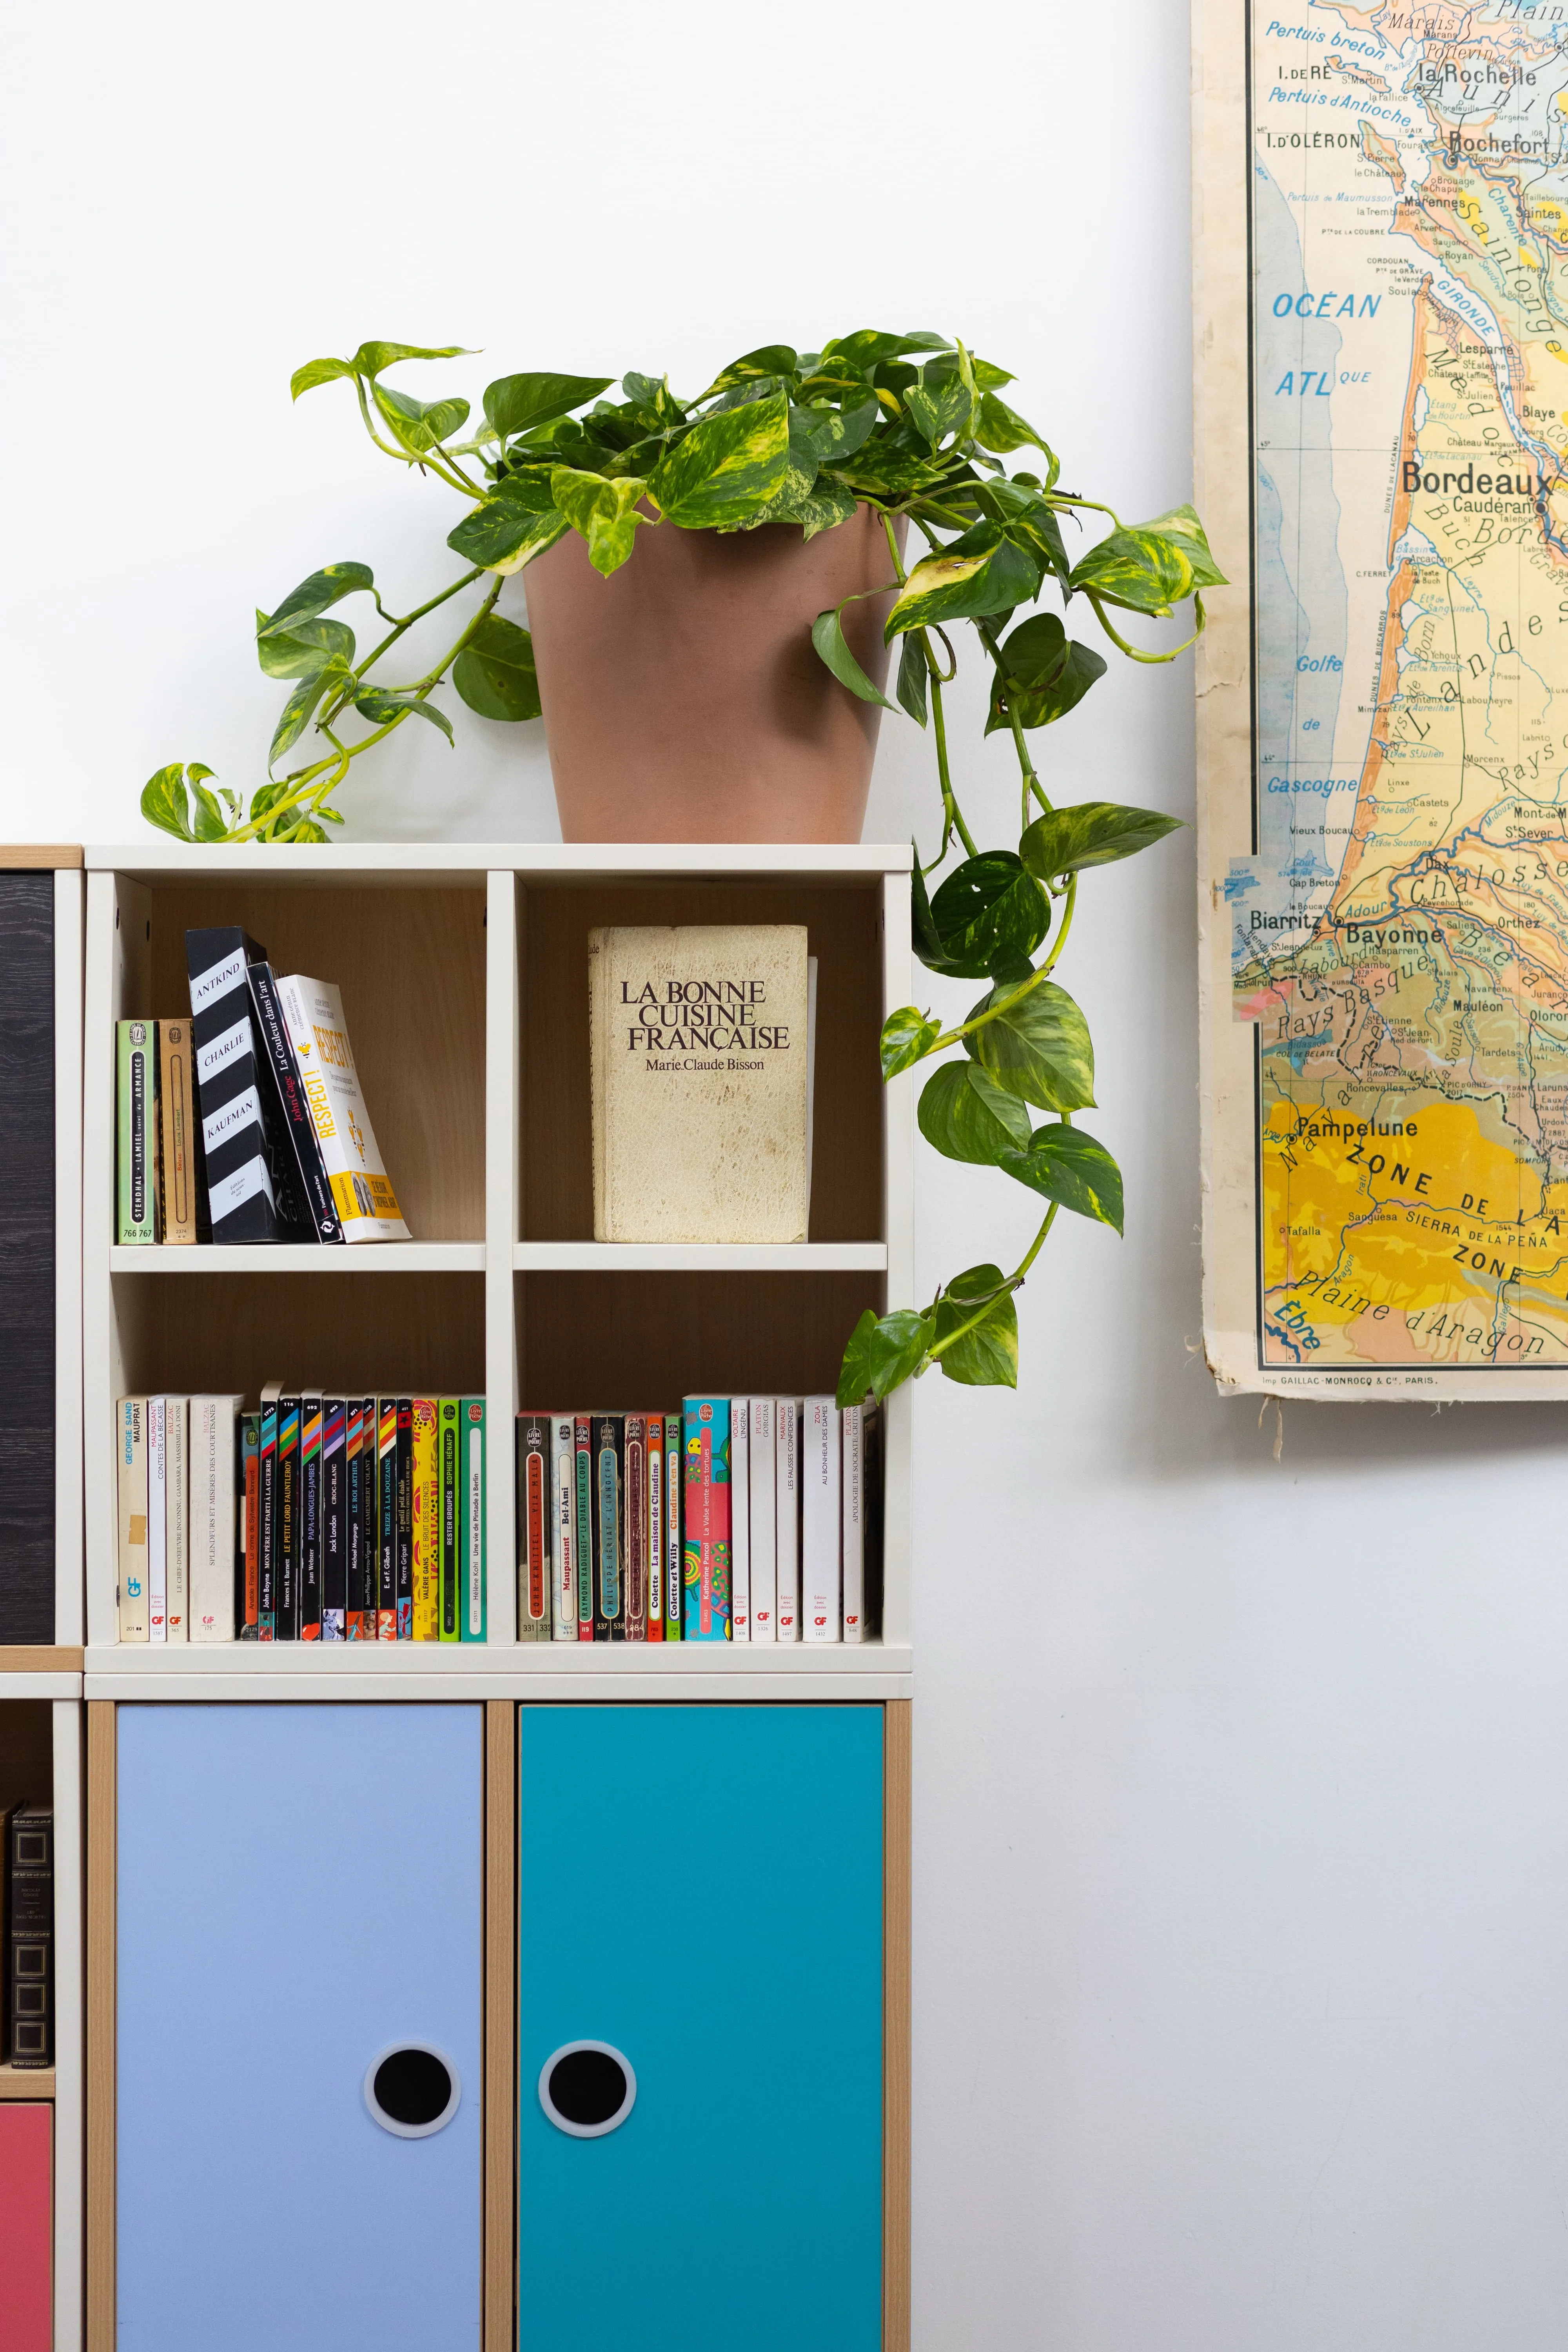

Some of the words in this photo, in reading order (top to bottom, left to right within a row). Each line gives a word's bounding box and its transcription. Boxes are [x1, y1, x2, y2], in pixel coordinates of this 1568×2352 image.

[1388, 13, 1455, 30] Marais
[1266, 21, 1325, 43] Pertuis
[1331, 34, 1386, 60] breton
[1445, 64, 1537, 84] Rochelle
[1377, 93, 1408, 102] Pallice
[1268, 87, 1326, 105] Pertuis
[1329, 93, 1411, 127] d'Antioche
[1397, 141, 1428, 150] Fouras
[1450, 131, 1550, 154] Rochefort
[1364, 169, 1404, 177] Château
[1437, 177, 1475, 186] Brouage
[1287, 192, 1319, 201] Pertuis
[1336, 193, 1393, 202] Maumusson
[1429, 185, 1463, 194] Chapus
[1404, 198, 1465, 208] Marennes
[1367, 208, 1415, 216] Tremblade
[1516, 209, 1561, 219] Saintes
[1414, 223, 1443, 232] Arvert
[1445, 251, 1473, 262] Royan
[1388, 287, 1422, 296] Soulac
[1273, 292, 1381, 318] OCÉAN
[1437, 279, 1495, 338] GIRONDE
[1459, 343, 1513, 357] Lesparre
[1275, 372, 1330, 396] ATL
[1500, 382, 1535, 392] Pauillac
[1522, 405, 1555, 419] Blaye
[1402, 461, 1553, 496] Bordeaux
[1453, 497, 1531, 514] Caudéran
[1410, 554, 1453, 563] Arcachon
[1297, 655, 1343, 672] Golfe
[1462, 696, 1512, 706] Labouheyre
[1303, 719, 1320, 731] de
[1466, 754, 1505, 764] Morcenx
[1268, 777, 1357, 798] Gascogne
[1413, 798, 1449, 808] Castets
[1290, 826, 1316, 835] Vieux
[1319, 826, 1353, 835] Boucau
[1426, 858, 1449, 869] Dax
[1289, 878, 1307, 888] Cap
[1309, 878, 1340, 886] Breton
[1345, 902, 1387, 919] Adour
[1423, 898, 1474, 909] Peyrehorade
[1251, 911, 1322, 929] Biarritz
[1446, 920, 1474, 929] Salies
[1498, 917, 1540, 929] Orthez
[1347, 926, 1442, 948] Bayonne
[1368, 946, 1419, 958] Hasparren
[196, 963, 240, 999] ANTKIND
[258, 980, 269, 998] l'art
[620, 981, 660, 1004] LA
[666, 981, 766, 1004] BONNE
[1277, 1004, 1334, 1040] Pays
[1343, 955, 1429, 1014] Basque
[265, 999, 275, 1020] dans
[1454, 1000, 1503, 1013] Mauléon
[639, 1004, 756, 1027] CUISINE
[270, 1022, 286, 1060] Couleur
[627, 1027, 790, 1052] FRANÇAISE
[204, 1033, 245, 1067] CHARLIE
[1482, 1048, 1515, 1057] Tardets
[281, 1061, 289, 1071] La
[727, 1058, 764, 1070] Bisson
[286, 1075, 296, 1099] Gage
[291, 1098, 301, 1122] John
[208, 1100, 252, 1138] KAUFMAN
[1298, 1117, 1417, 1144] Pampelune
[1347, 1144, 1433, 1195] ZONE
[1461, 1193, 1489, 1216] DE
[339, 1177, 352, 1216] Flammarion
[1287, 1226, 1321, 1235] Tafalla
[1406, 1212, 1460, 1237] SIERRA
[1469, 1230, 1483, 1241] DE
[1488, 1235, 1501, 1243] LA
[1508, 1232, 1548, 1248] PEÑA
[1334, 1254, 1355, 1286] Aragon
[1454, 1245, 1524, 1285] ZONE
[1291, 1269, 1391, 1320] Plaine
[1406, 1311, 1546, 1356] d'Aragon
[652, 1507, 658, 1517] de
[652, 1555, 659, 1566] La
[670, 1572, 677, 1581] et
[128, 1577, 141, 1597] GF
